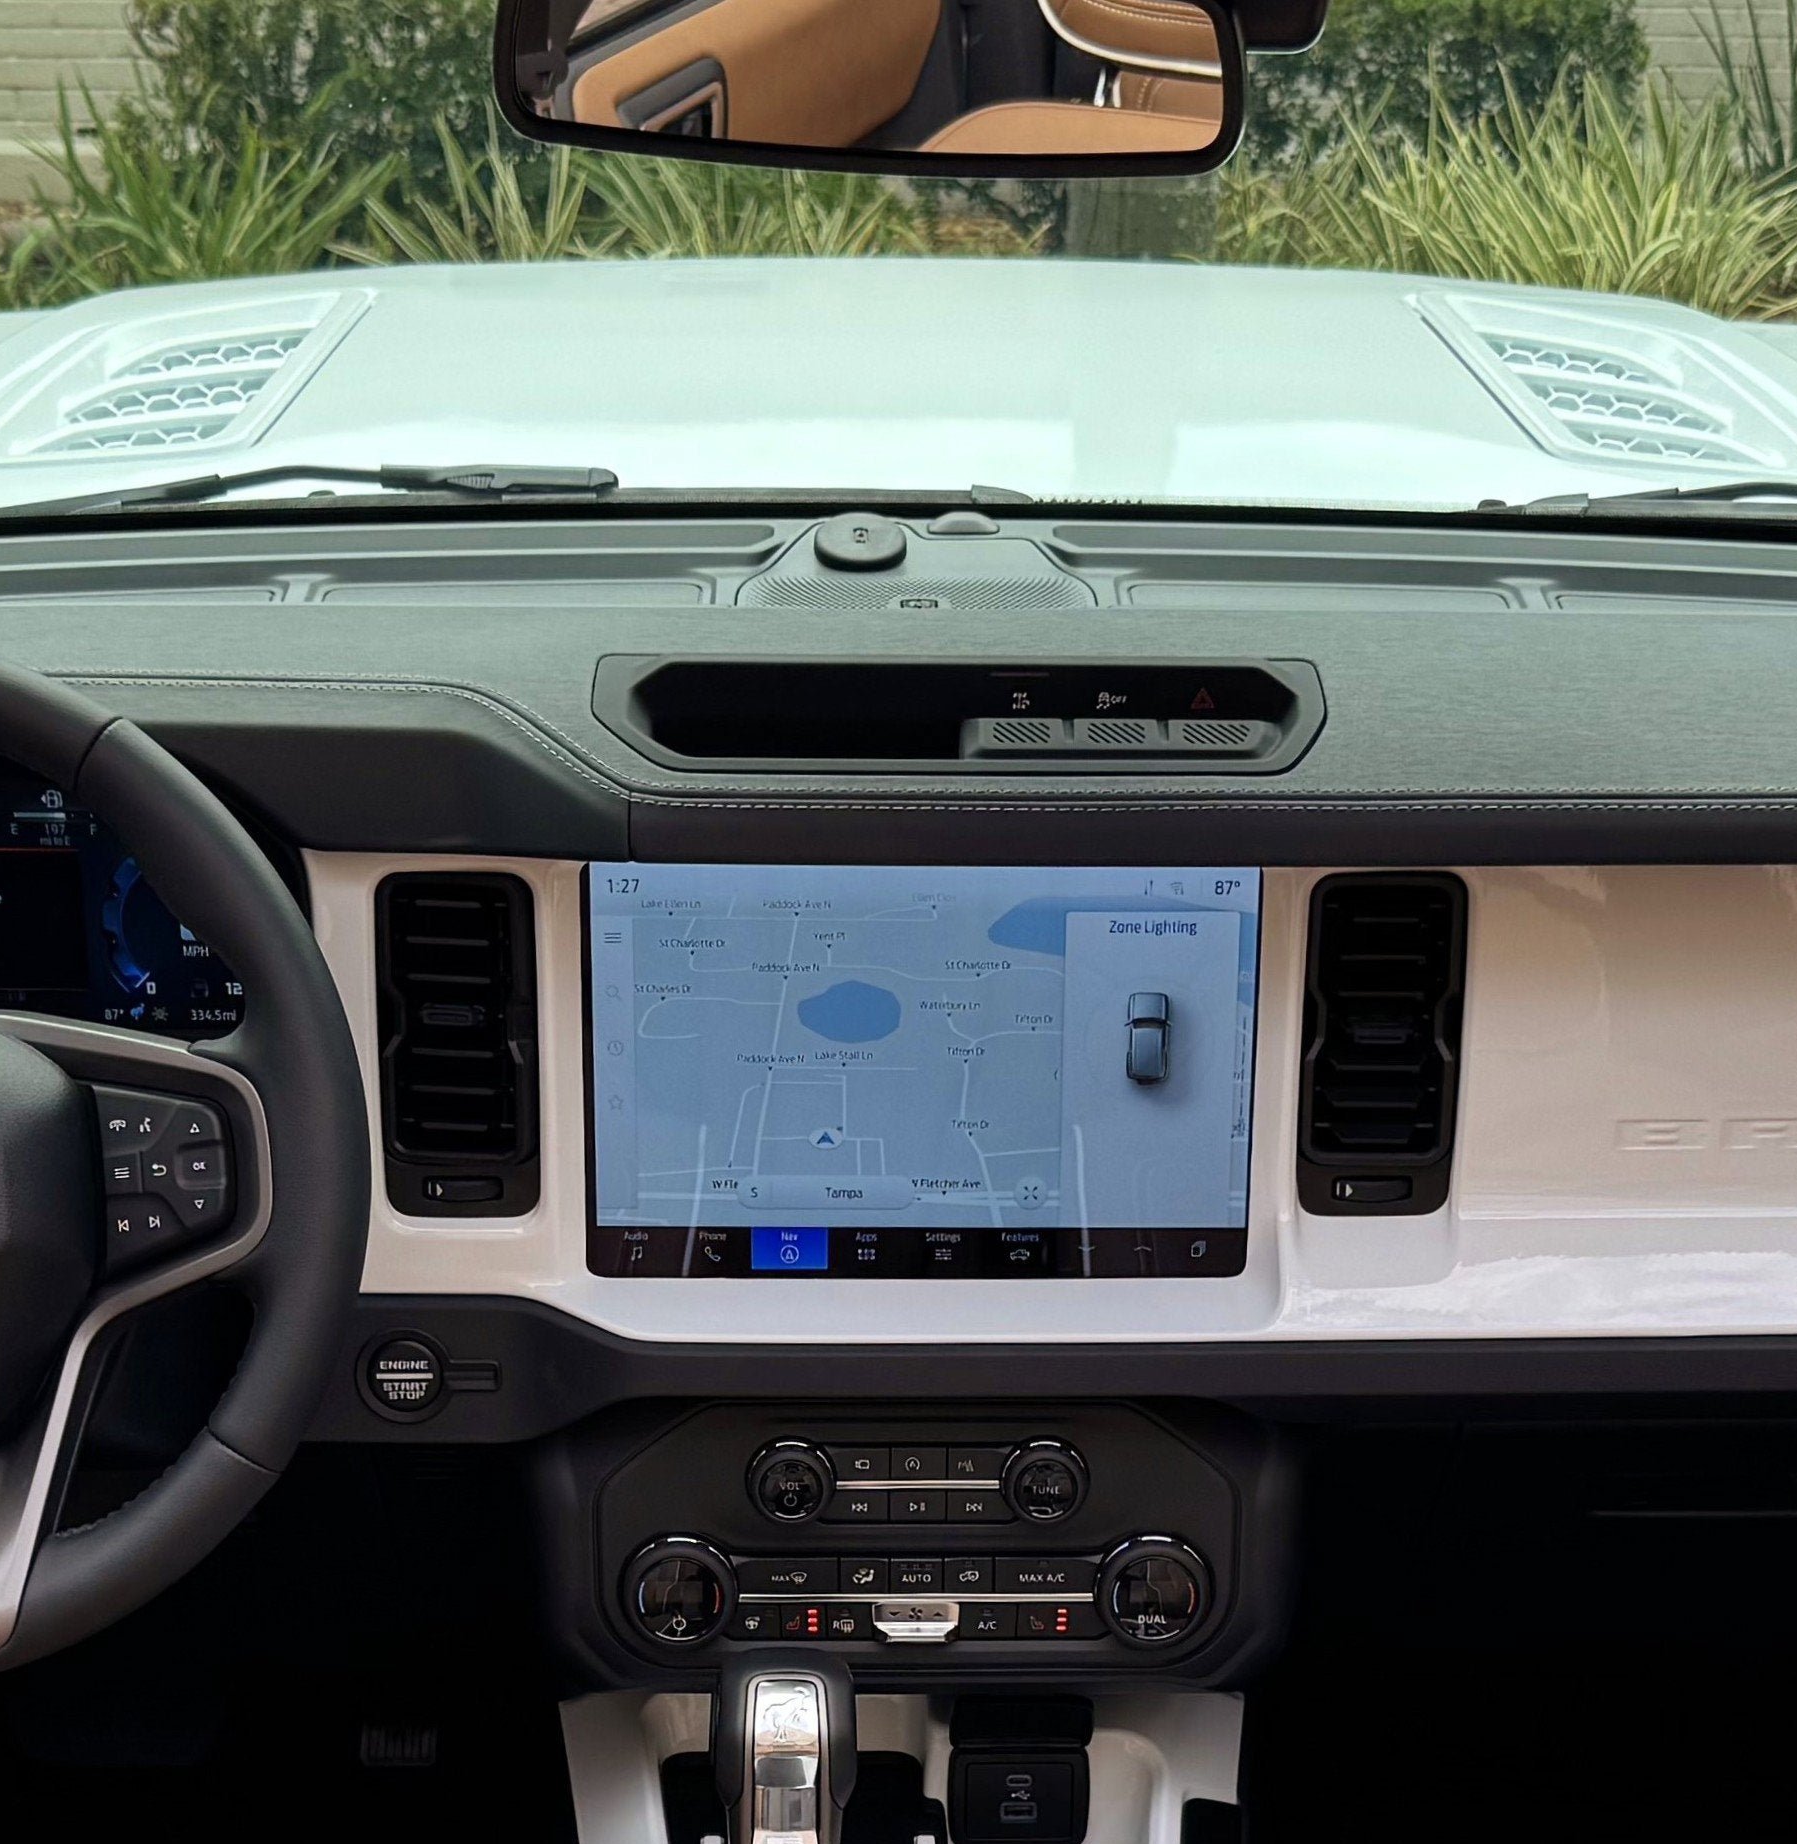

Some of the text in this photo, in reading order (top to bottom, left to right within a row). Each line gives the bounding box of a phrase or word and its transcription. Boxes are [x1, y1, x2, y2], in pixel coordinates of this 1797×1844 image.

[606, 878, 640, 894] 1:27
[1214, 880, 1241, 895] 87°
[1109, 920, 1197, 936] Zone Lighting
[183, 945, 210, 957] MPH
[825, 1187, 863, 1199] Tampa
[379, 1360, 429, 1370] ENGINE
[1033, 1485, 1060, 1495] TUNE
[902, 1573, 932, 1583] AUTO
[1019, 1573, 1066, 1583] MAX A/C
[1137, 1614, 1167, 1625] DUAL
[978, 1620, 997, 1631] A/C
